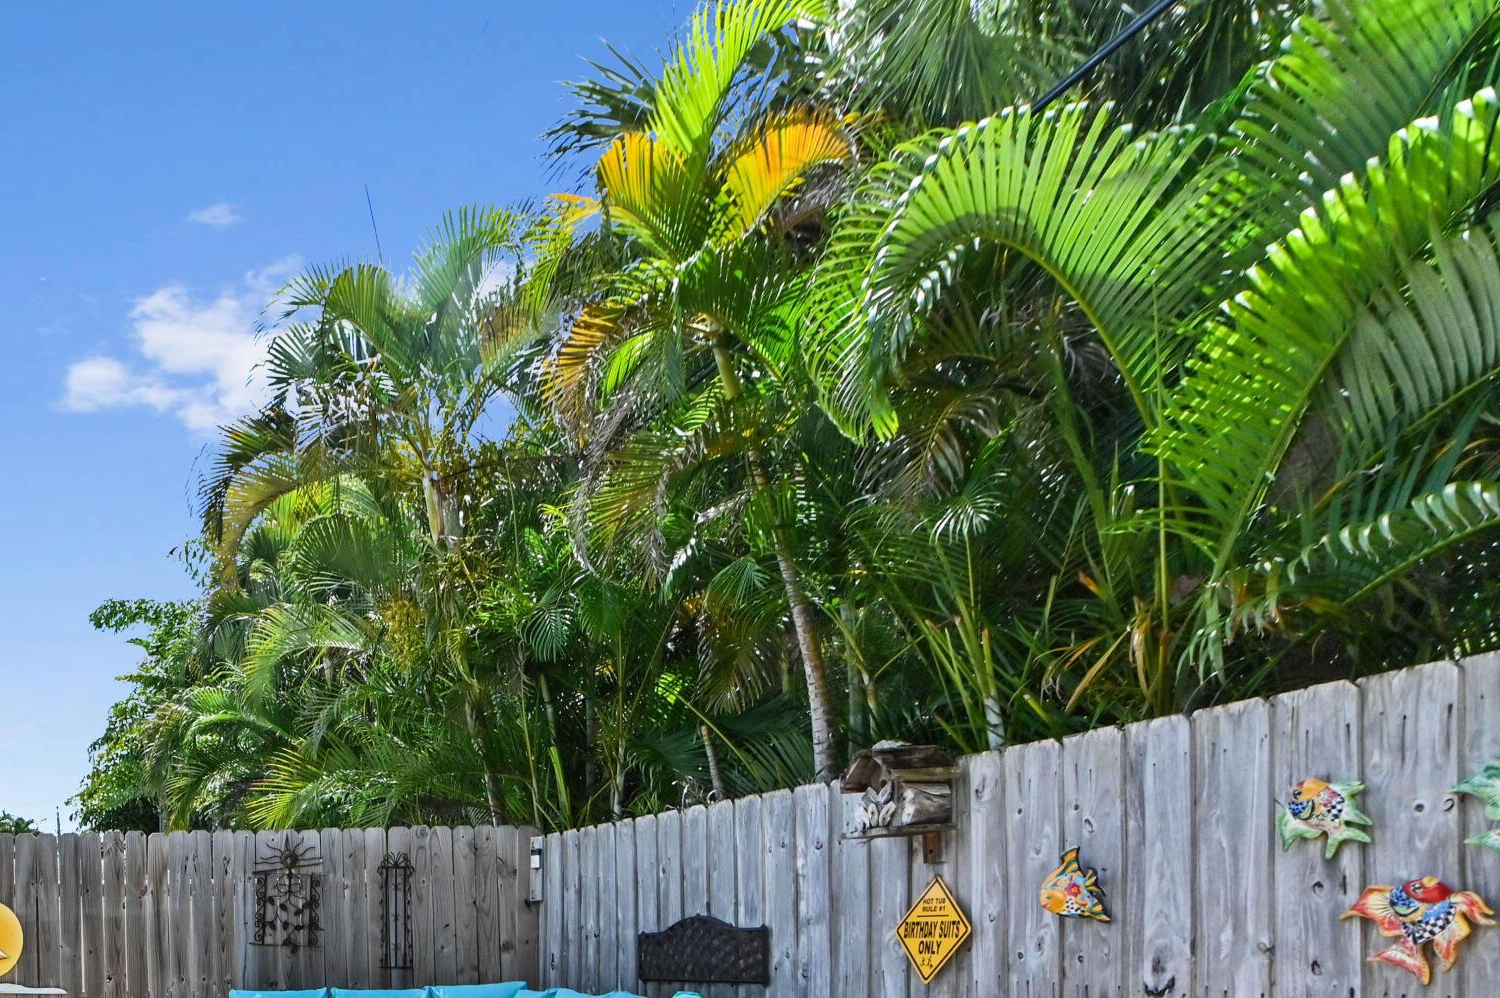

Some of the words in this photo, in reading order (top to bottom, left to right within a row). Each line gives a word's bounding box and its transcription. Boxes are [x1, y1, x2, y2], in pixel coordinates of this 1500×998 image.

[904, 921, 938, 939] BIRTHDAY
[939, 920, 960, 939] SUITS
[918, 941, 942, 955] ONLY
